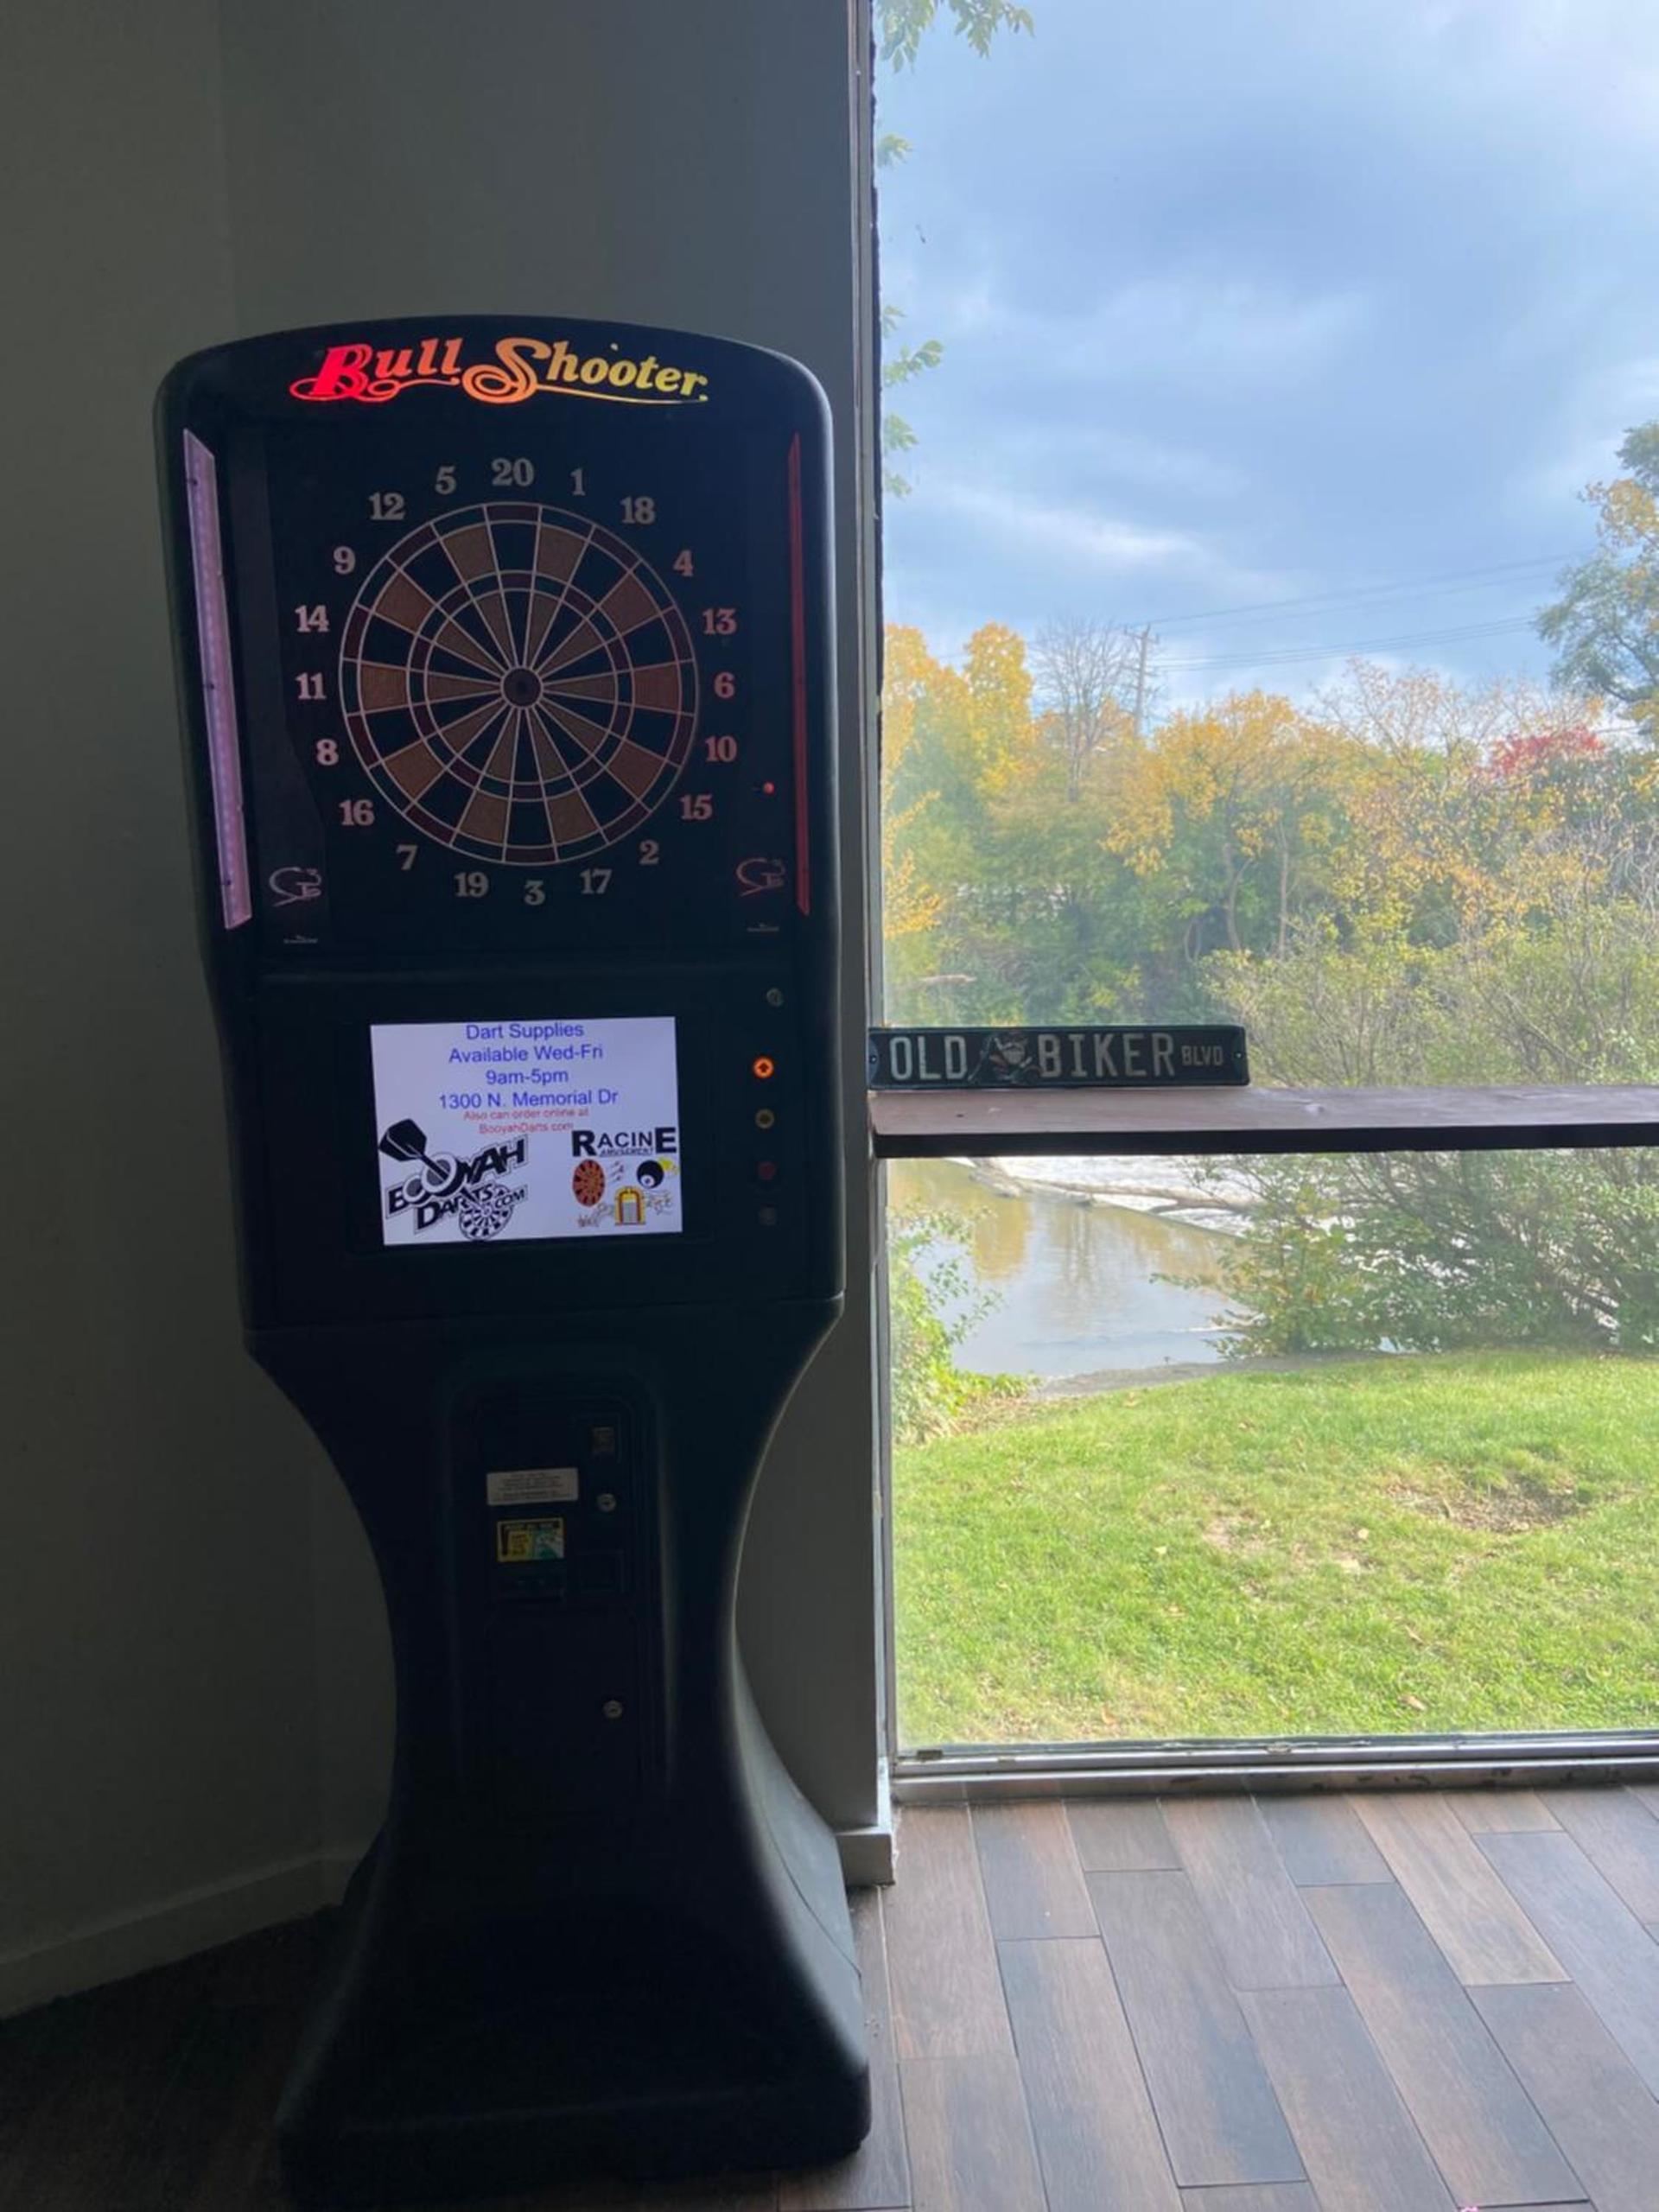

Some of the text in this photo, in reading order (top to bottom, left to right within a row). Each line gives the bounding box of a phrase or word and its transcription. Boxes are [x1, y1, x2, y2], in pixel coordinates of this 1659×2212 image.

[289, 338, 463, 402] Bull
[435, 466, 456, 494] 5
[493, 458, 534, 486] 20
[570, 468, 586, 495] 1
[369, 493, 405, 519] 12
[620, 497, 655, 524] 18
[334, 546, 356, 574] 9
[674, 550, 694, 576] 4
[295, 605, 329, 632] 14
[703, 608, 736, 634] 13
[296, 673, 326, 699] 11
[715, 672, 734, 698] 6
[316, 740, 339, 765] 8
[705, 736, 737, 762] 10
[340, 800, 375, 826] 16
[680, 794, 713, 819] 15
[396, 845, 418, 870] 7
[639, 840, 658, 865] 2
[454, 872, 489, 897] 19
[524, 880, 546, 906] 3
[581, 869, 613, 894] 17
[466, 1022, 585, 1042] Dart Supplies
[448, 1044, 604, 1063] Available Wed-Fri
[889, 1033, 1224, 1081] OLD BIKER BLVD
[485, 1068, 569, 1085] 9am-5pm
[439, 1088, 619, 1109] 1300 N. Memorial Dr
[463, 1107, 589, 1121] Also can order online at
